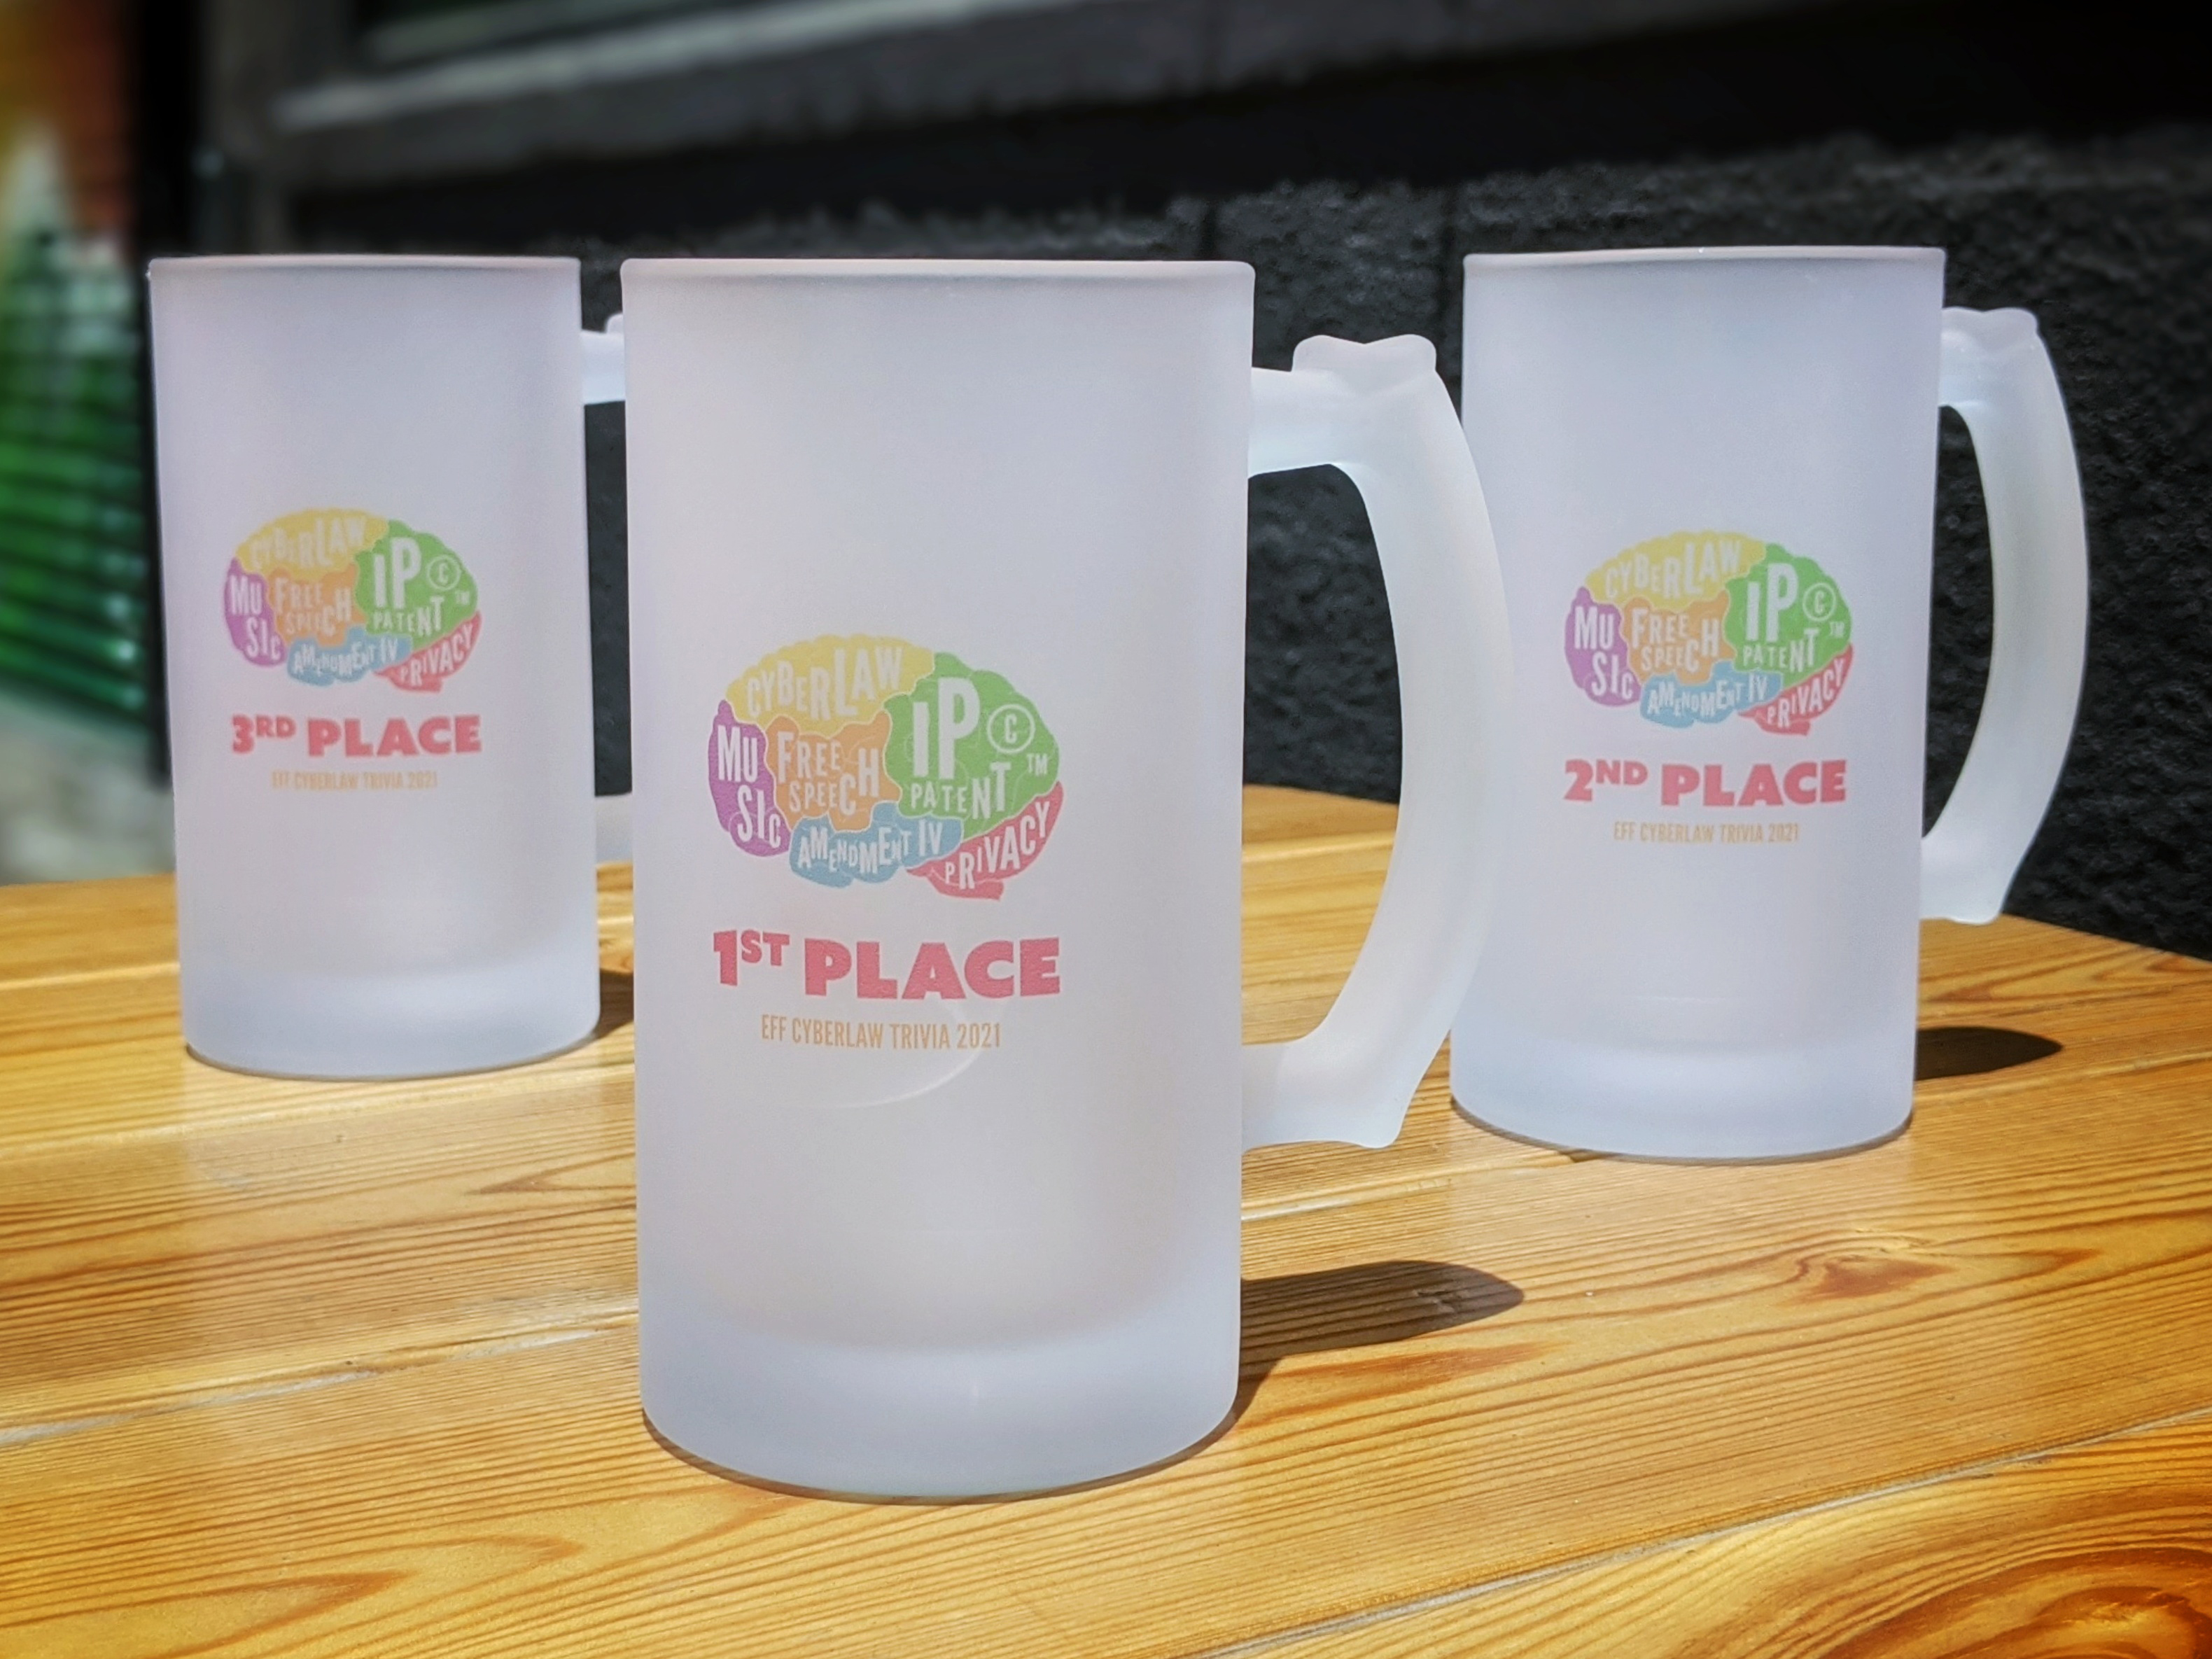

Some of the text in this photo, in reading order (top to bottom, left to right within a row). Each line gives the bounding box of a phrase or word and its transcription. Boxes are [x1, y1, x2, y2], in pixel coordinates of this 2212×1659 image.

[374, 537, 421, 609] IP
[1605, 540, 1742, 600] CYBERLAW
[373, 596, 444, 636] PATENT
[1574, 606, 1614, 650] MU
[1746, 563, 1798, 643] IP
[381, 638, 398, 662] IV
[400, 622, 473, 687] PRIVACY
[1632, 608, 1688, 655] FREE
[1642, 619, 1718, 672] SPEECH
[1743, 629, 1820, 672] PATENT
[748, 647, 902, 721] CYBERLAW
[1647, 673, 1768, 718] AMENDMENT IV
[1767, 659, 1844, 727] PRIVACY
[232, 713, 482, 757] 3RD PLACE
[718, 724, 758, 783] MU
[913, 677, 979, 780] IP
[777, 731, 841, 783] FREE
[790, 748, 879, 816] SPEECH
[1563, 759, 1847, 806] 2ND PLACE
[737, 785, 781, 848] SIC
[911, 762, 1011, 820] PATENT
[798, 819, 941, 874] AMENDMENT IV
[945, 801, 1050, 890] PRIVACY
[1614, 821, 1799, 844] EFF CYBERLAW TRIVIA 2021
[713, 929, 1060, 1000] 1ST PLACE
[761, 1014, 1002, 1049] EFF CYBERLAW TRIVIA 2021
